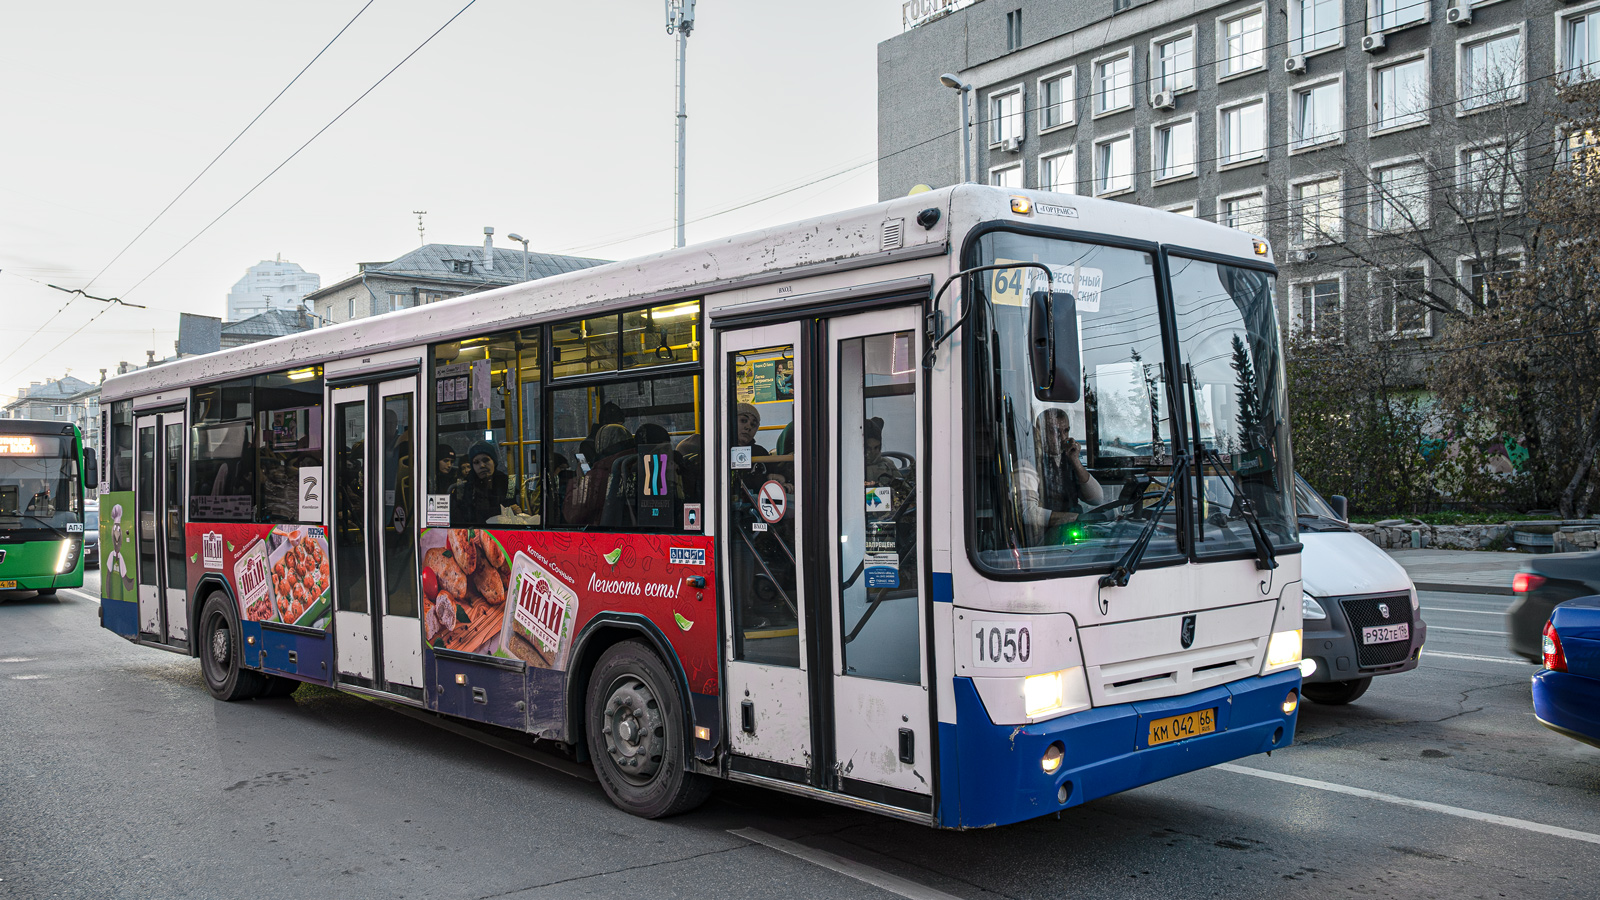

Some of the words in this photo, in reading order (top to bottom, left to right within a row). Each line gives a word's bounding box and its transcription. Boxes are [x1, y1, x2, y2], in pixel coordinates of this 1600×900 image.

[1040, 204, 1074, 215] «ГОРТРАНС»
[778, 285, 792, 293] ВХОД
[995, 268, 1022, 296] 64
[1028, 268, 1101, 287] КМРЕССОРНЫЙ
[68, 524, 82, 532] АП-2
[866, 541, 896, 549] ЗАПРЕЩЕН!
[241, 559, 265, 596] ИНДИ
[526, 544, 549, 567] Котлеты
[548, 562, 576, 585] «Сочные»
[587, 571, 641, 596] Легкость
[644, 577, 683, 599] есть!
[519, 578, 564, 637] ИНДИ
[975, 626, 1031, 663] 1050
[1365, 627, 1398, 643] Р932ТЕ
[1153, 724, 1169, 742] КМ
[1172, 716, 1194, 737] 042
[1199, 710, 1211, 726] 66
